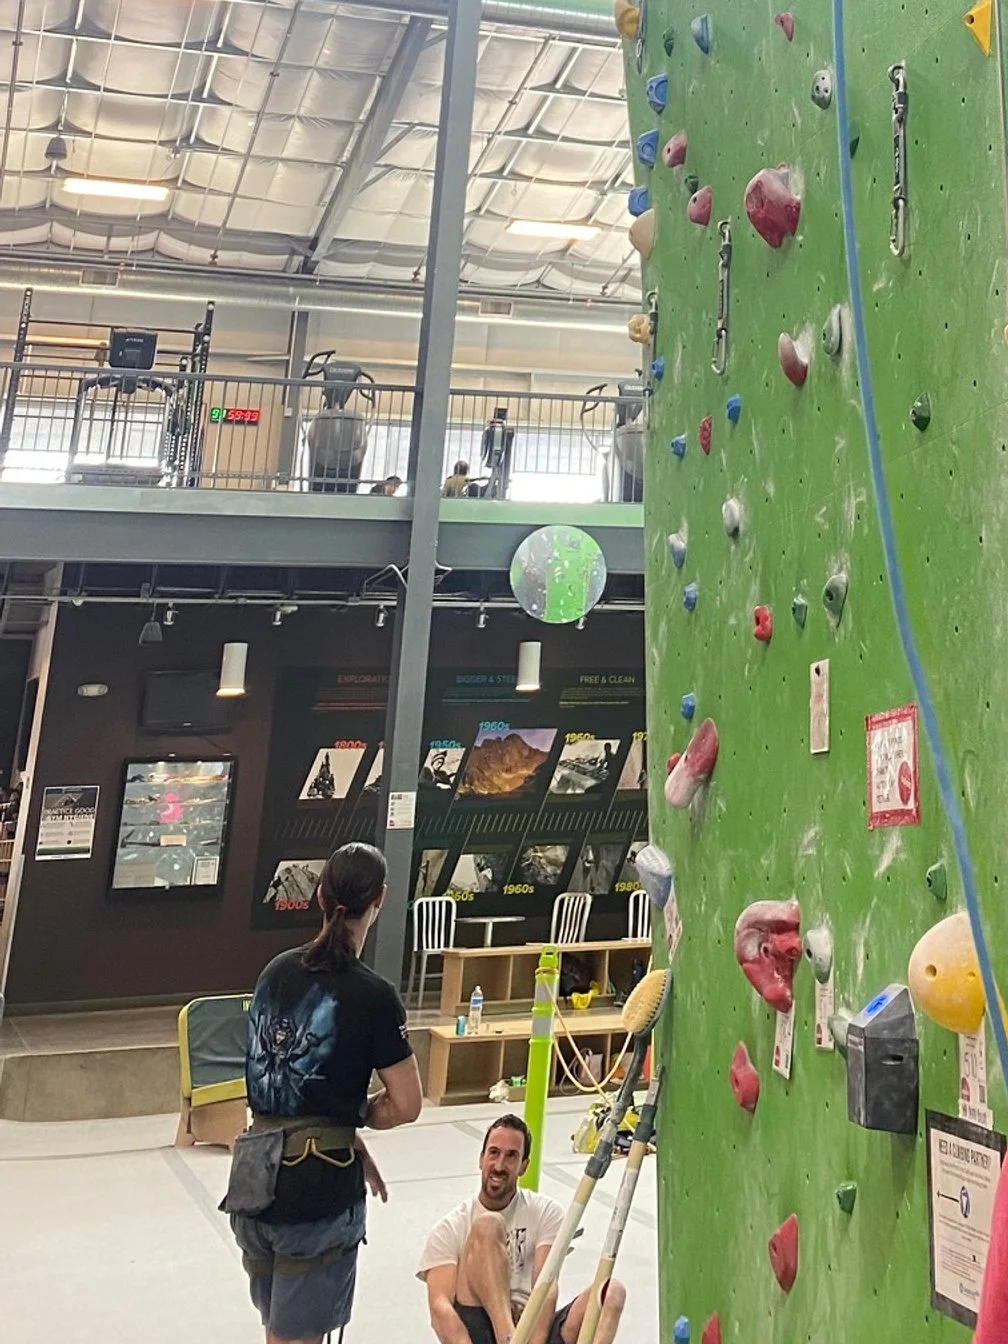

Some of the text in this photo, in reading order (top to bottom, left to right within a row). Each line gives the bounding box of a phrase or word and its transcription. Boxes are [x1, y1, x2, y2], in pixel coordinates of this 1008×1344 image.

[580, 675, 599, 684] FREE
[608, 674, 636, 684] CLEAN
[479, 721, 511, 731] 1960s
[502, 883, 535, 895] 1960s
[274, 899, 309, 911] 1900s
